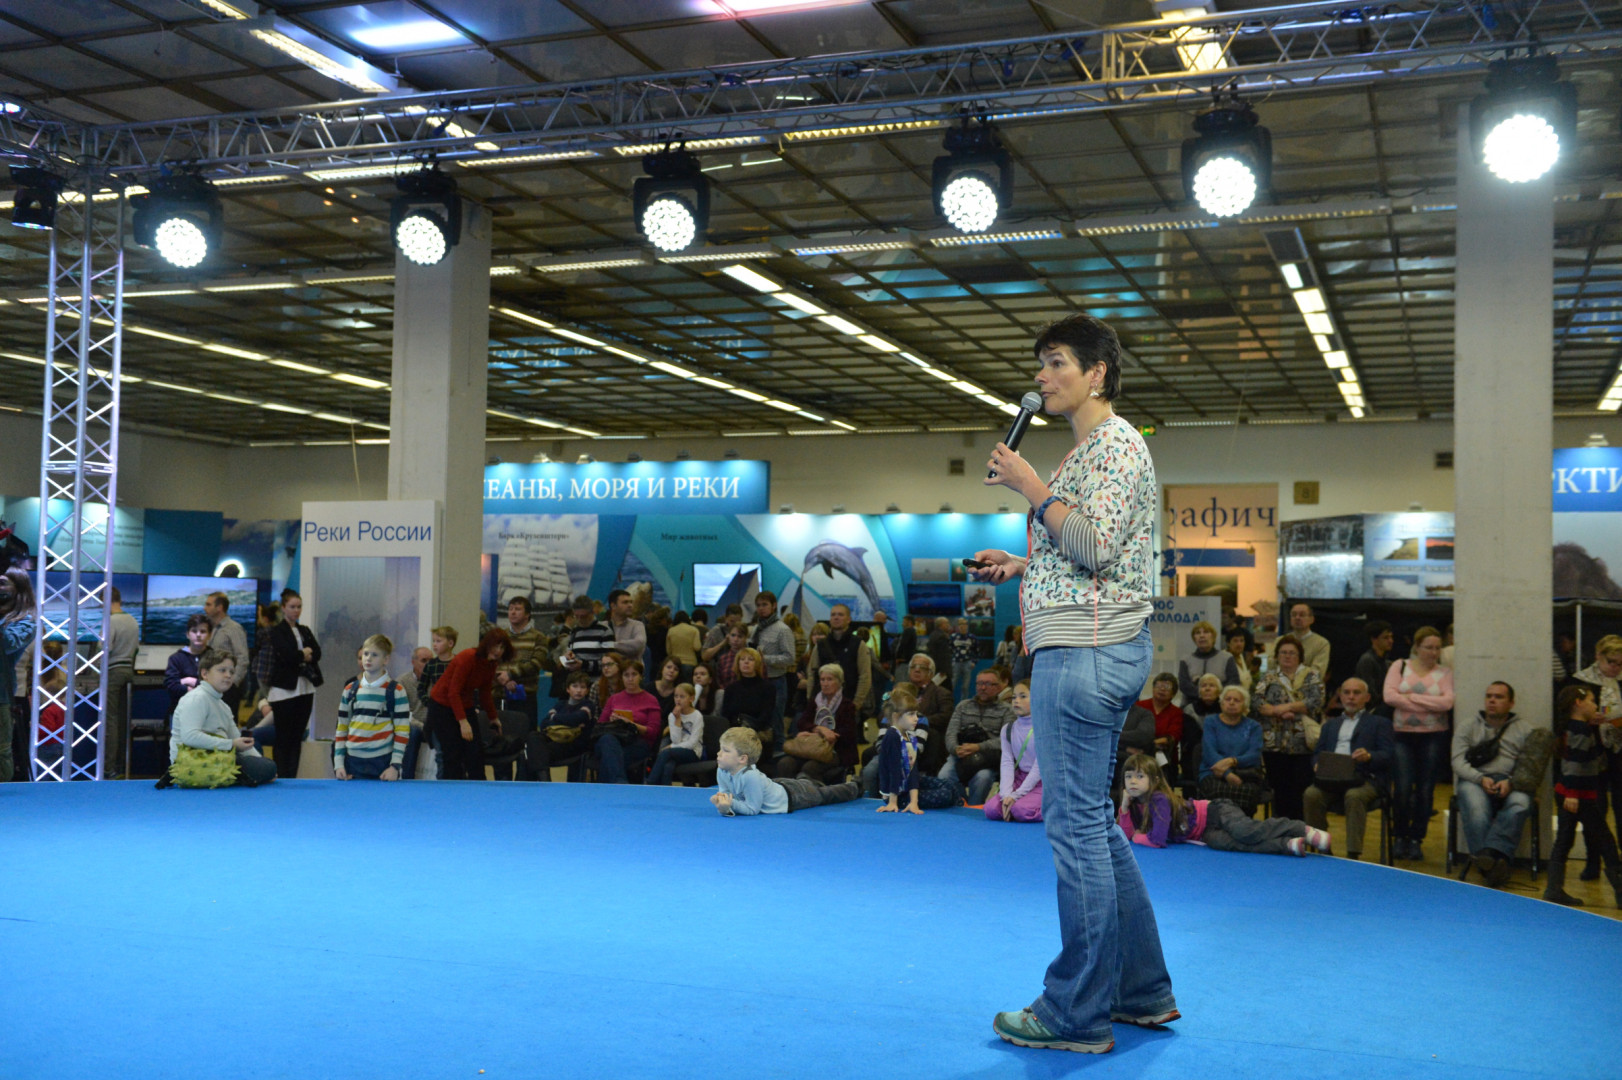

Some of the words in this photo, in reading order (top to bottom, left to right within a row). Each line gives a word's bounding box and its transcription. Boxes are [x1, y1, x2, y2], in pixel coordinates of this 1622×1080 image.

[483, 478, 563, 501] ЕАНЫ,
[569, 477, 640, 499] МОРЯ
[646, 477, 666, 498] И
[672, 476, 741, 499] РЕКИ
[1552, 467, 1622, 494] КТИ
[304, 521, 351, 542] Реки
[358, 520, 432, 541] России
